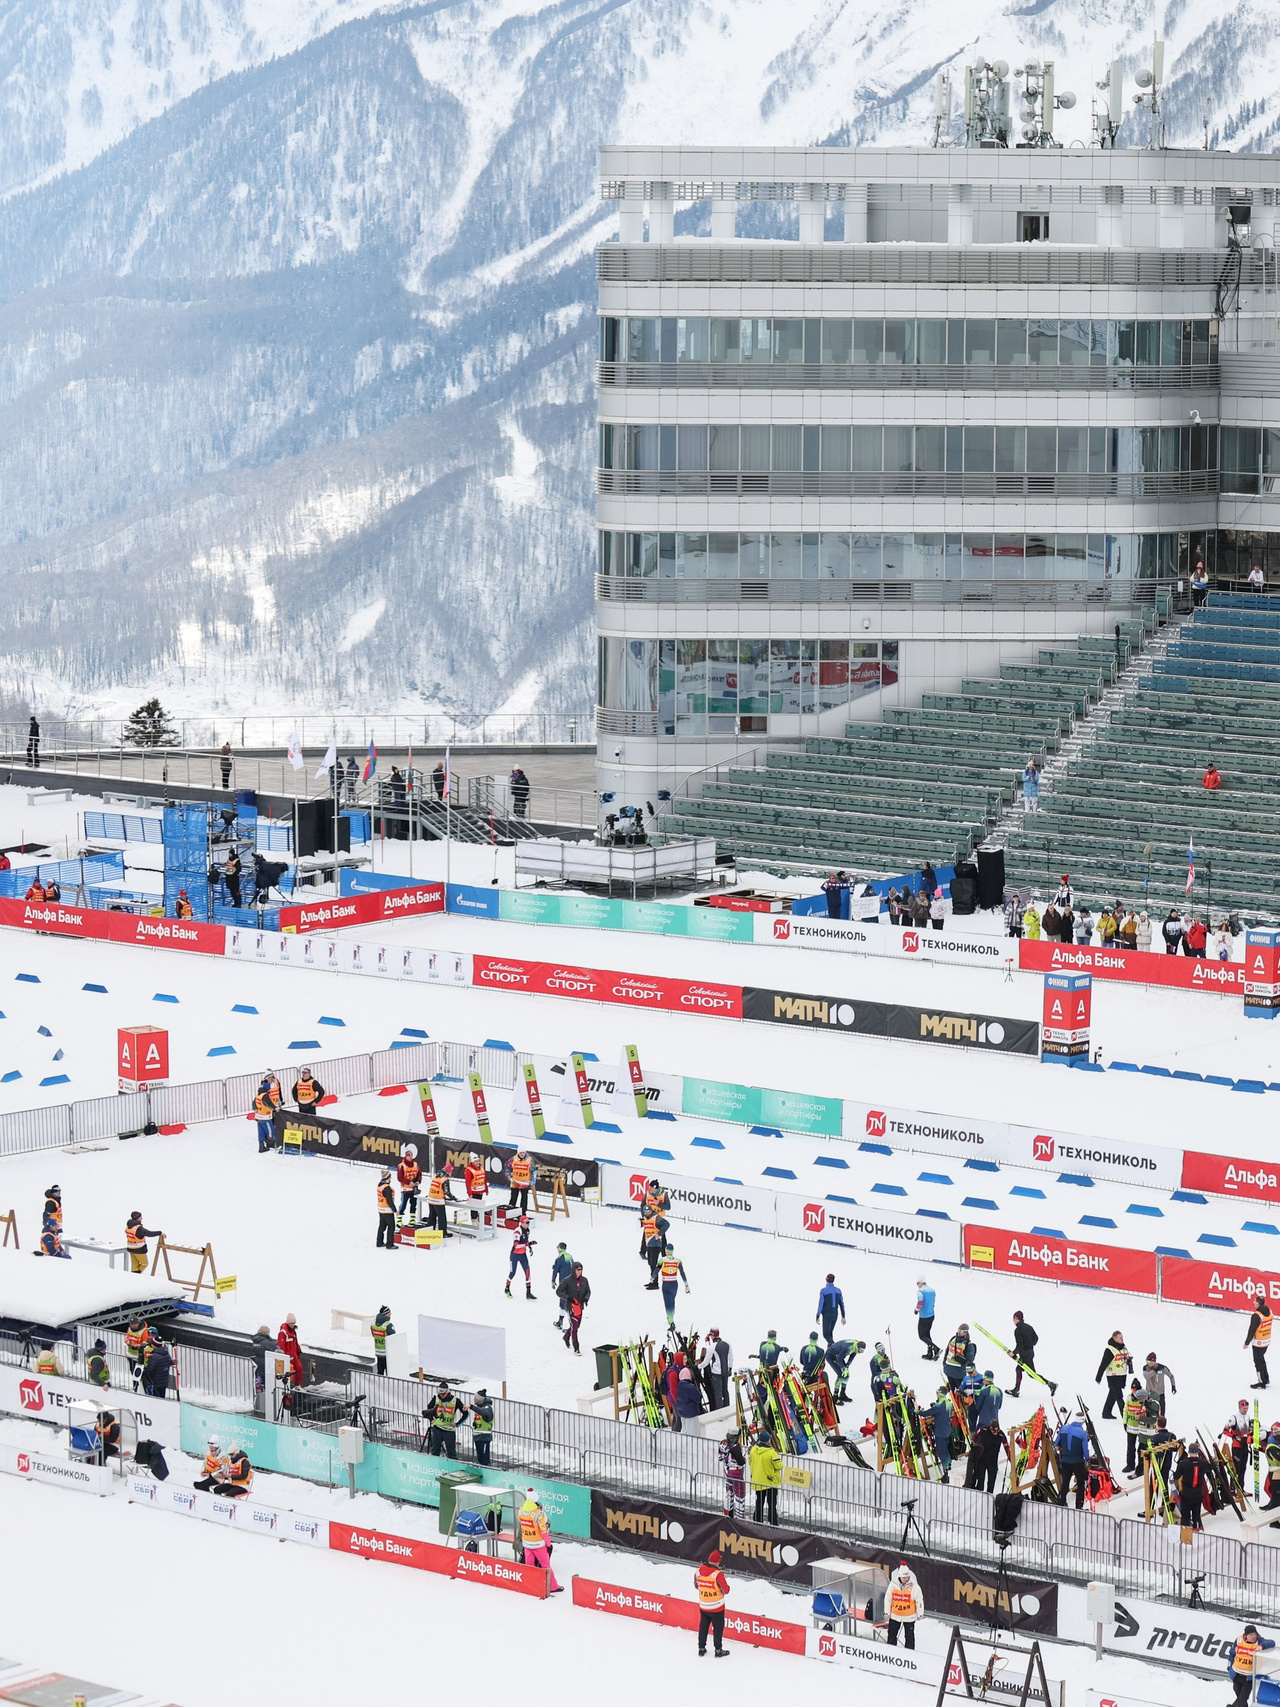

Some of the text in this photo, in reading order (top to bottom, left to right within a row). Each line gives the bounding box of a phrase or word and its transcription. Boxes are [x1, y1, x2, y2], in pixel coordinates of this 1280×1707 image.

[384, 890, 442, 909] Альфа Банк
[24, 905, 83, 925] Альфа Банк
[300, 904, 357, 924] Альфа Банк
[136, 921, 198, 940] Альфа Банк
[793, 926, 867, 942] ТЕХНОНИКОЛЬ
[1249, 934, 1271, 944] ФИНИШ
[921, 939, 1000, 956] ТЕХНОНИКОЛЬ
[488, 962, 524, 973] Советский
[1051, 948, 1126, 970] Альфа Банк
[480, 970, 530, 984] СПОРТ
[553, 969, 591, 981] Советский
[620, 977, 659, 989] Советский
[1047, 977, 1069, 988] ФИНИШ
[1074, 977, 1090, 989] ФИНИШ
[1192, 964, 1235, 985] Альфа
[546, 978, 597, 993] СПОРТ
[612, 986, 664, 1001] СПОРТ
[689, 985, 728, 998] Советский
[680, 994, 735, 1010] СПОРТ
[889, 1121, 984, 1144] ТЕХНОНИКОЛЬ
[1058, 1145, 1157, 1170] ТЕХНОНИКОЛЬ
[1224, 1164, 1277, 1189] Альфа
[661, 1186, 752, 1212] ЕХНОНИКОЛЬ
[829, 1215, 934, 1244] ТЕХНОНИКОЛЬ
[1008, 1239, 1110, 1272] Альфа Банк
[1209, 1272, 1266, 1298] Альфа
[32, 1461, 91, 1482] ТЕХНОНИКОЛЬ
[134, 1486, 150, 1494] СБР
[173, 1494, 189, 1504] СБР
[213, 1504, 229, 1514] СБР
[253, 1513, 270, 1523] СБР
[294, 1523, 311, 1533] СБР
[350, 1531, 413, 1557] Альфа Банк
[457, 1556, 523, 1583] Альфа Банк
[596, 1587, 664, 1614] Альфа Банк
[722, 1616, 783, 1640] льфа Банк
[839, 1644, 918, 1671] ТЕХНОНИКОЛЬ
